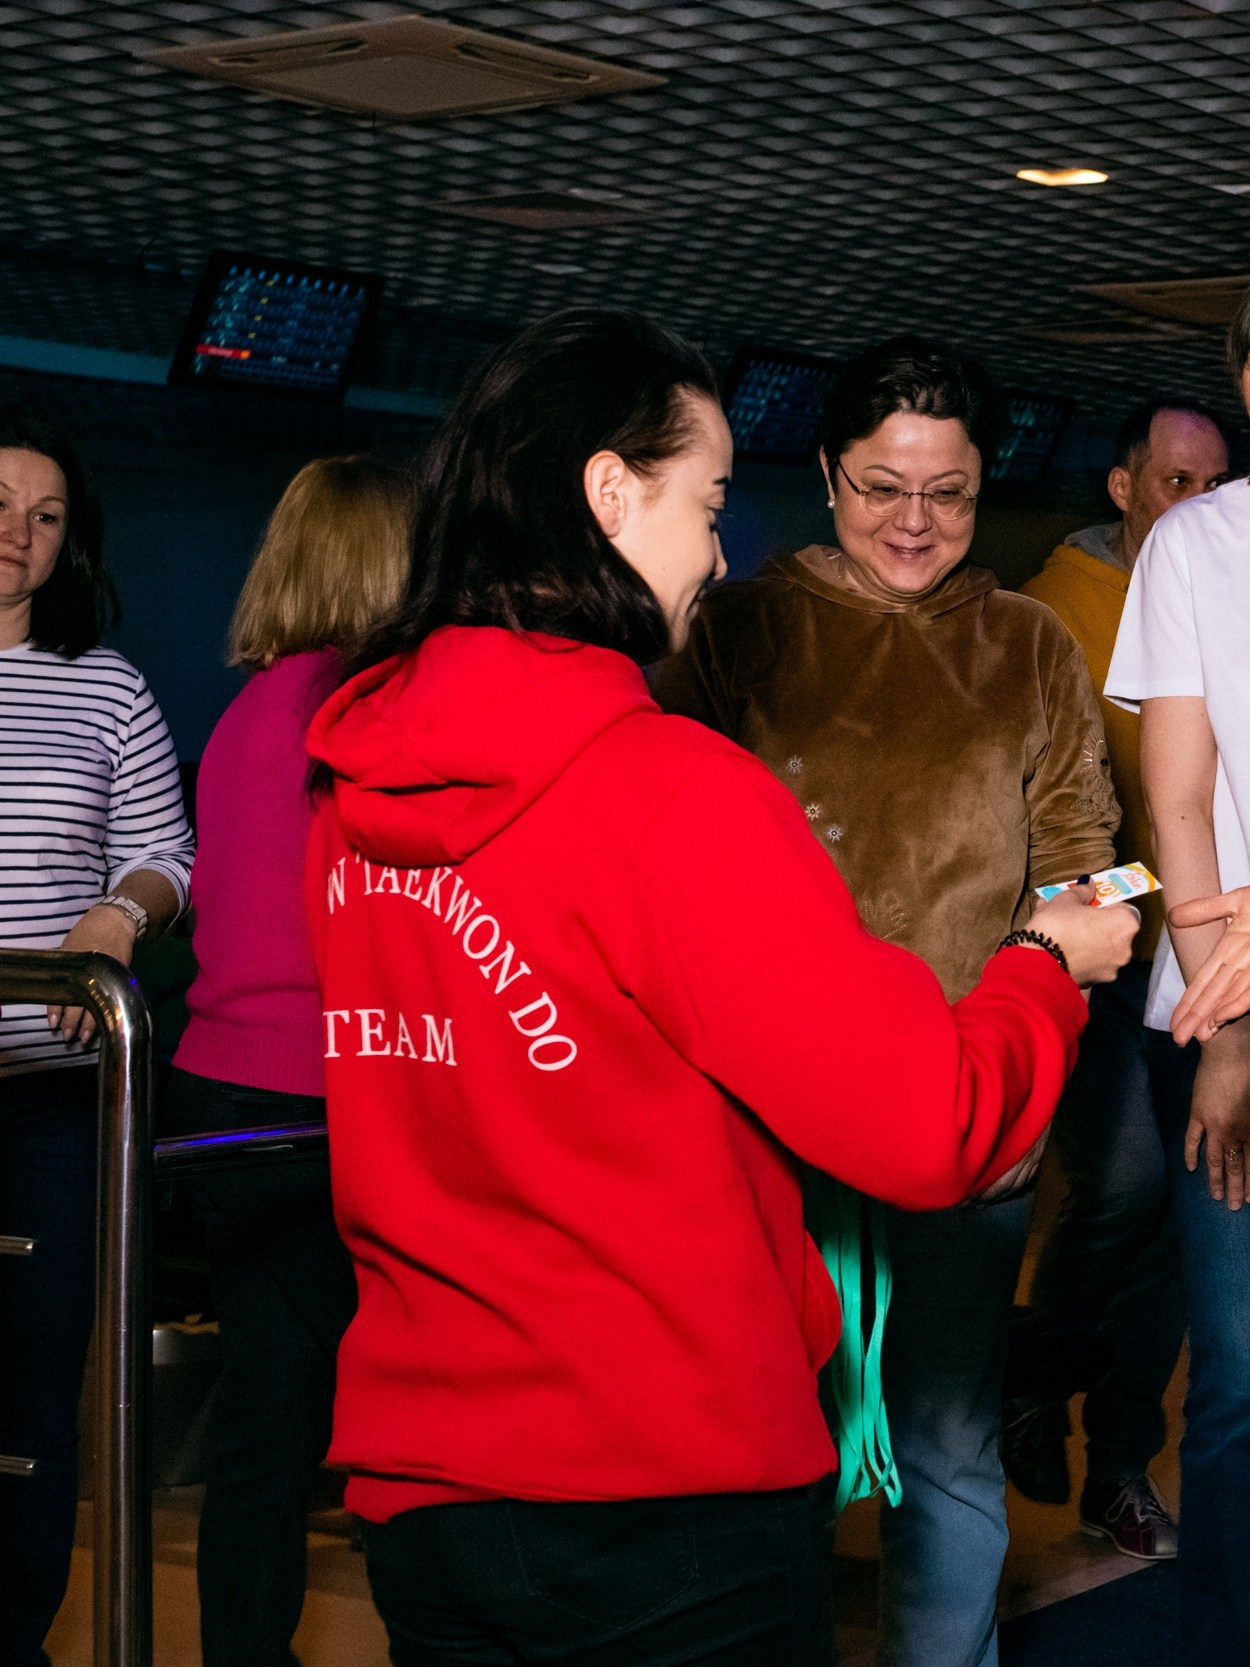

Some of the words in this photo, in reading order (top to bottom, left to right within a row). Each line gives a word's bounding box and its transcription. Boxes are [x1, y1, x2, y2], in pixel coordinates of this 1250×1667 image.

[355, 852, 532, 994] TAEKWON
[508, 991, 578, 1071] DO
[323, 1008, 458, 1067] TEAM
